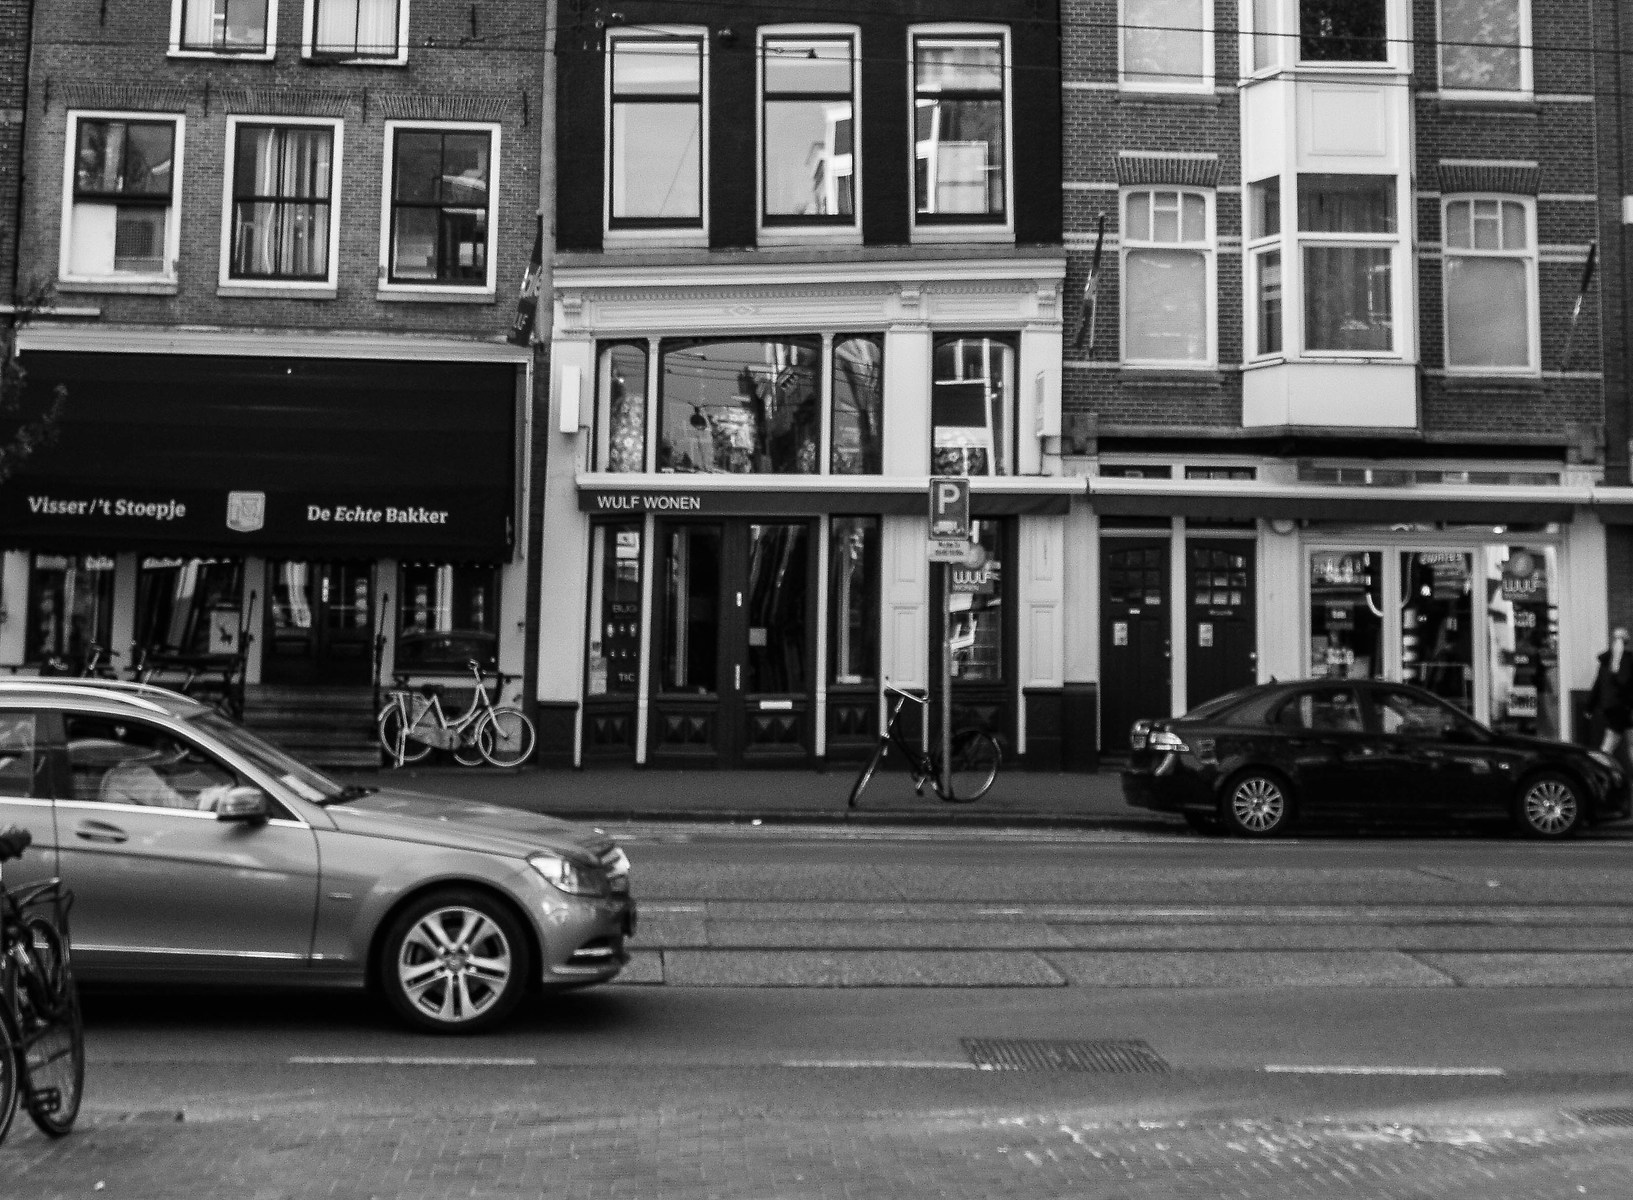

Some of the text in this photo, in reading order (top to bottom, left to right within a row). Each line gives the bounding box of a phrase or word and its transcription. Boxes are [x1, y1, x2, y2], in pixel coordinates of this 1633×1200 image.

[597, 496, 701, 510] WULF WONEN
[939, 484, 960, 514] P
[115, 499, 186, 520] Stoepje
[307, 505, 449, 524] De Echte Bakker
